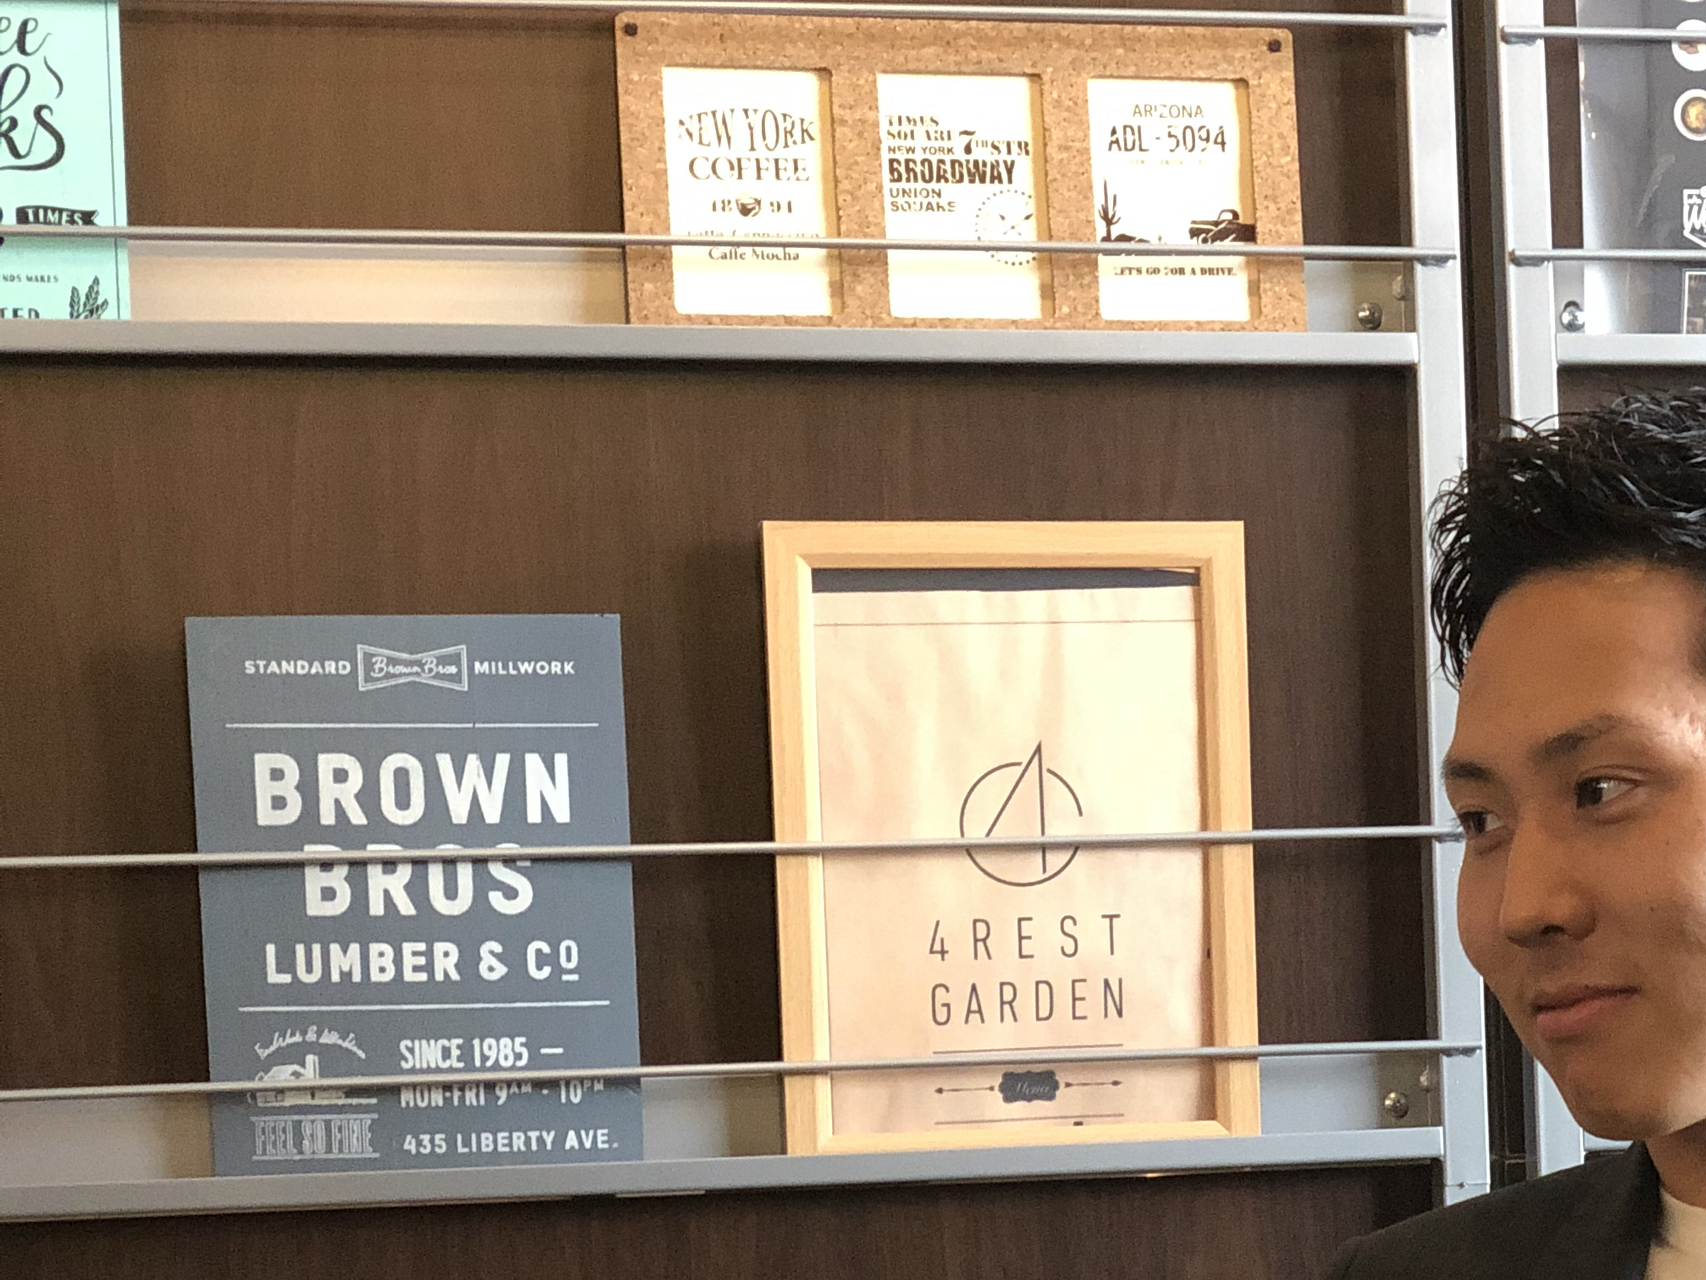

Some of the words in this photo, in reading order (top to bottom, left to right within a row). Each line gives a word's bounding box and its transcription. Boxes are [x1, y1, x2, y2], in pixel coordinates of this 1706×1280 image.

[885, 115, 940, 127] TIMES
[1132, 104, 1205, 119] ARIZONA
[678, 108, 735, 150] NEW
[742, 108, 816, 151] YORK
[887, 145, 916, 155] NEW
[921, 146, 955, 156] YORK
[688, 156, 809, 181] COFFEE
[888, 158, 1016, 185] BROADWAY
[889, 188, 942, 199] UNION
[26, 207, 83, 226] TIMES
[244, 660, 351, 675] STANDARD
[474, 660, 576, 676] MILLWORK
[253, 752, 572, 827] BROWN
[303, 843, 534, 918] BROS
[928, 913, 1121, 962] 4REST
[265, 942, 460, 985] LUMBER
[478, 940, 508, 981] &
[930, 977, 1125, 1026] GARDEN
[400, 1038, 465, 1071] SINCE
[473, 1036, 529, 1069] 1985
[403, 1133, 448, 1155] 435
[456, 1130, 556, 1154] LIBERTY
[564, 1128, 620, 1151] AVE.
